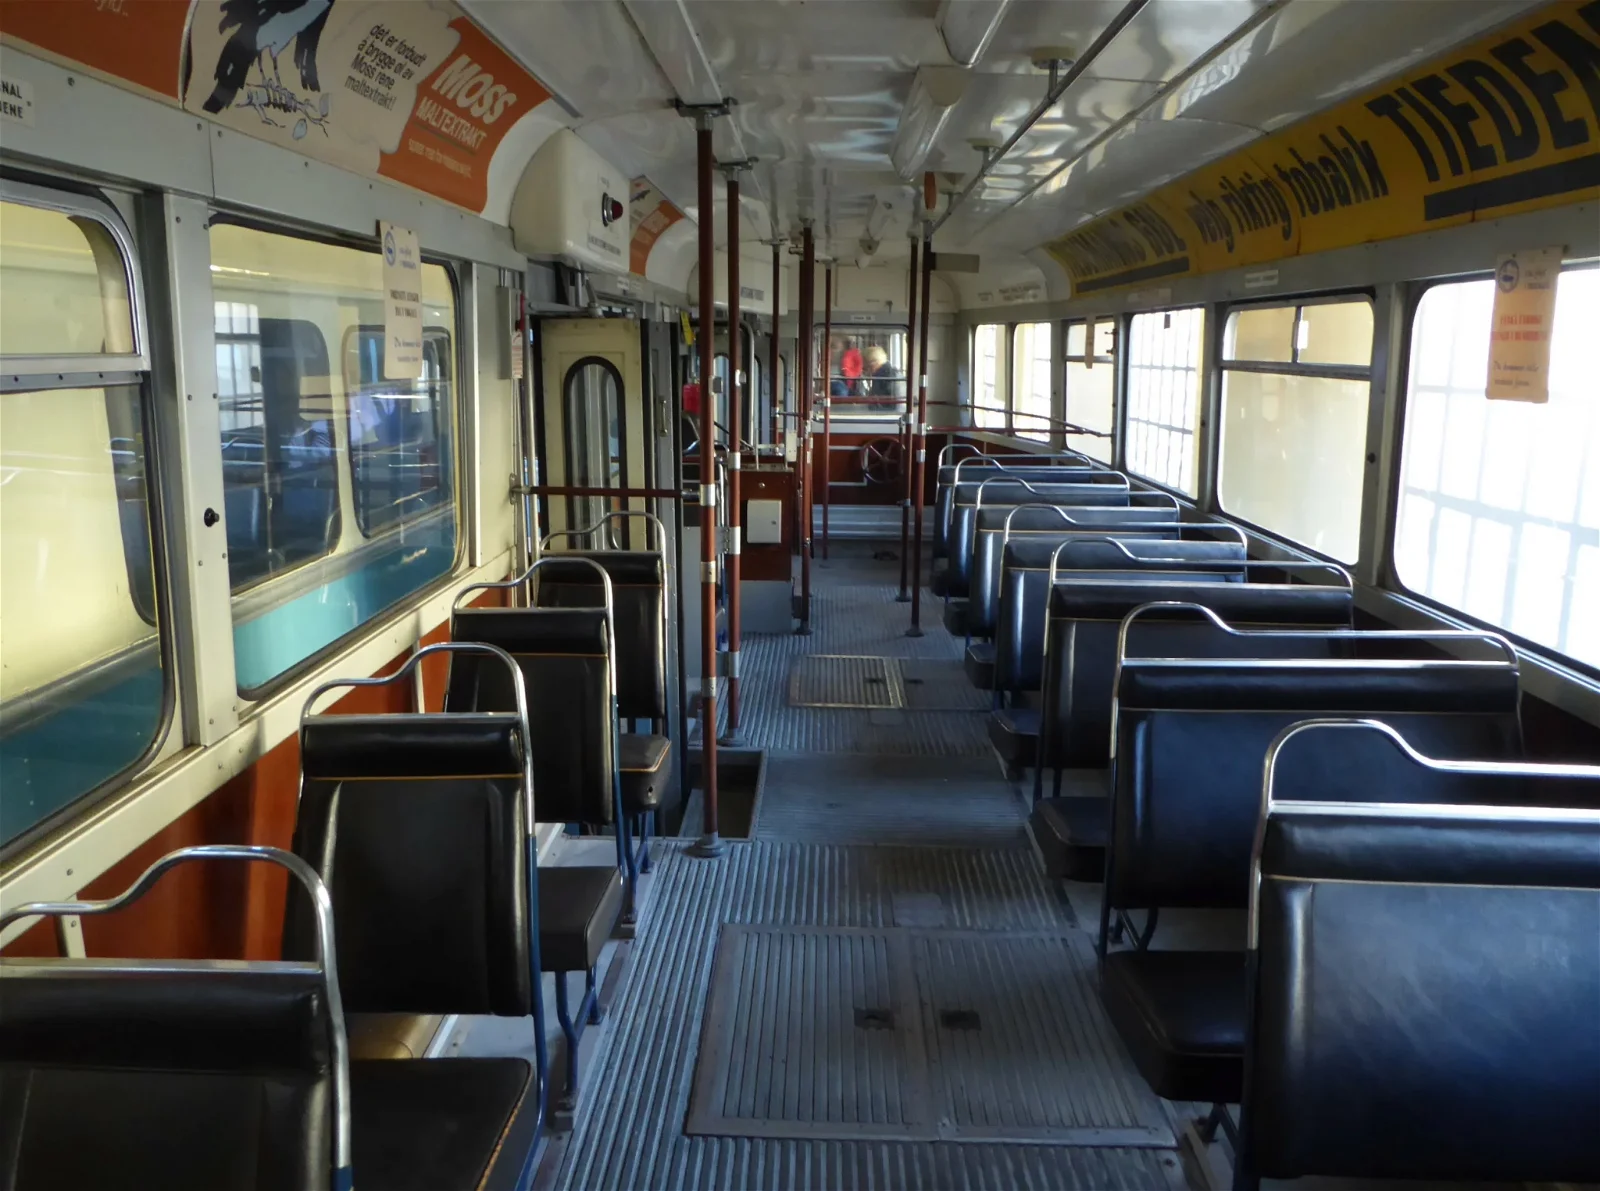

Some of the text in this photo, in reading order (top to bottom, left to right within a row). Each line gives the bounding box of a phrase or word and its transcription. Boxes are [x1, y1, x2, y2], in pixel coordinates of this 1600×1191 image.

[367, 38, 396, 73] brygge
[400, 66, 415, 81] av
[370, 23, 427, 68] det er forbudt
[0, 80, 22, 99] NAL
[351, 53, 396, 91] Moss rene
[431, 54, 518, 125] MOSS
[415, 96, 488, 150] MALTEXTRAKT
[1274, 125, 1389, 218] tobakk
